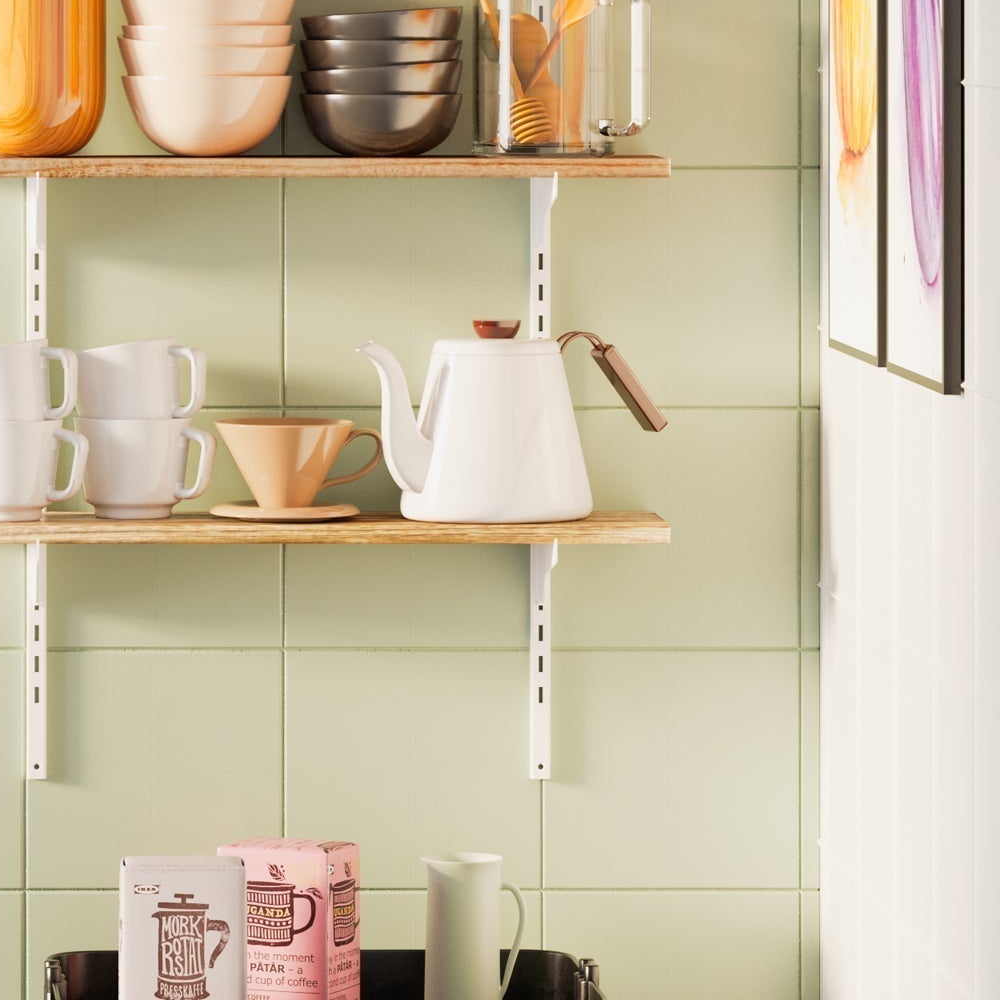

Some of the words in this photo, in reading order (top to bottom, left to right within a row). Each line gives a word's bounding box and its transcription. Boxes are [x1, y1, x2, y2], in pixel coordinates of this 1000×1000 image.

[253, 951, 270, 960] the
[272, 953, 315, 963] moment
[250, 960, 286, 974] PÅTÅR
[297, 967, 303, 975] a
[255, 976, 273, 988] cup
[275, 976, 286, 985] of
[288, 978, 318, 988] coffee
